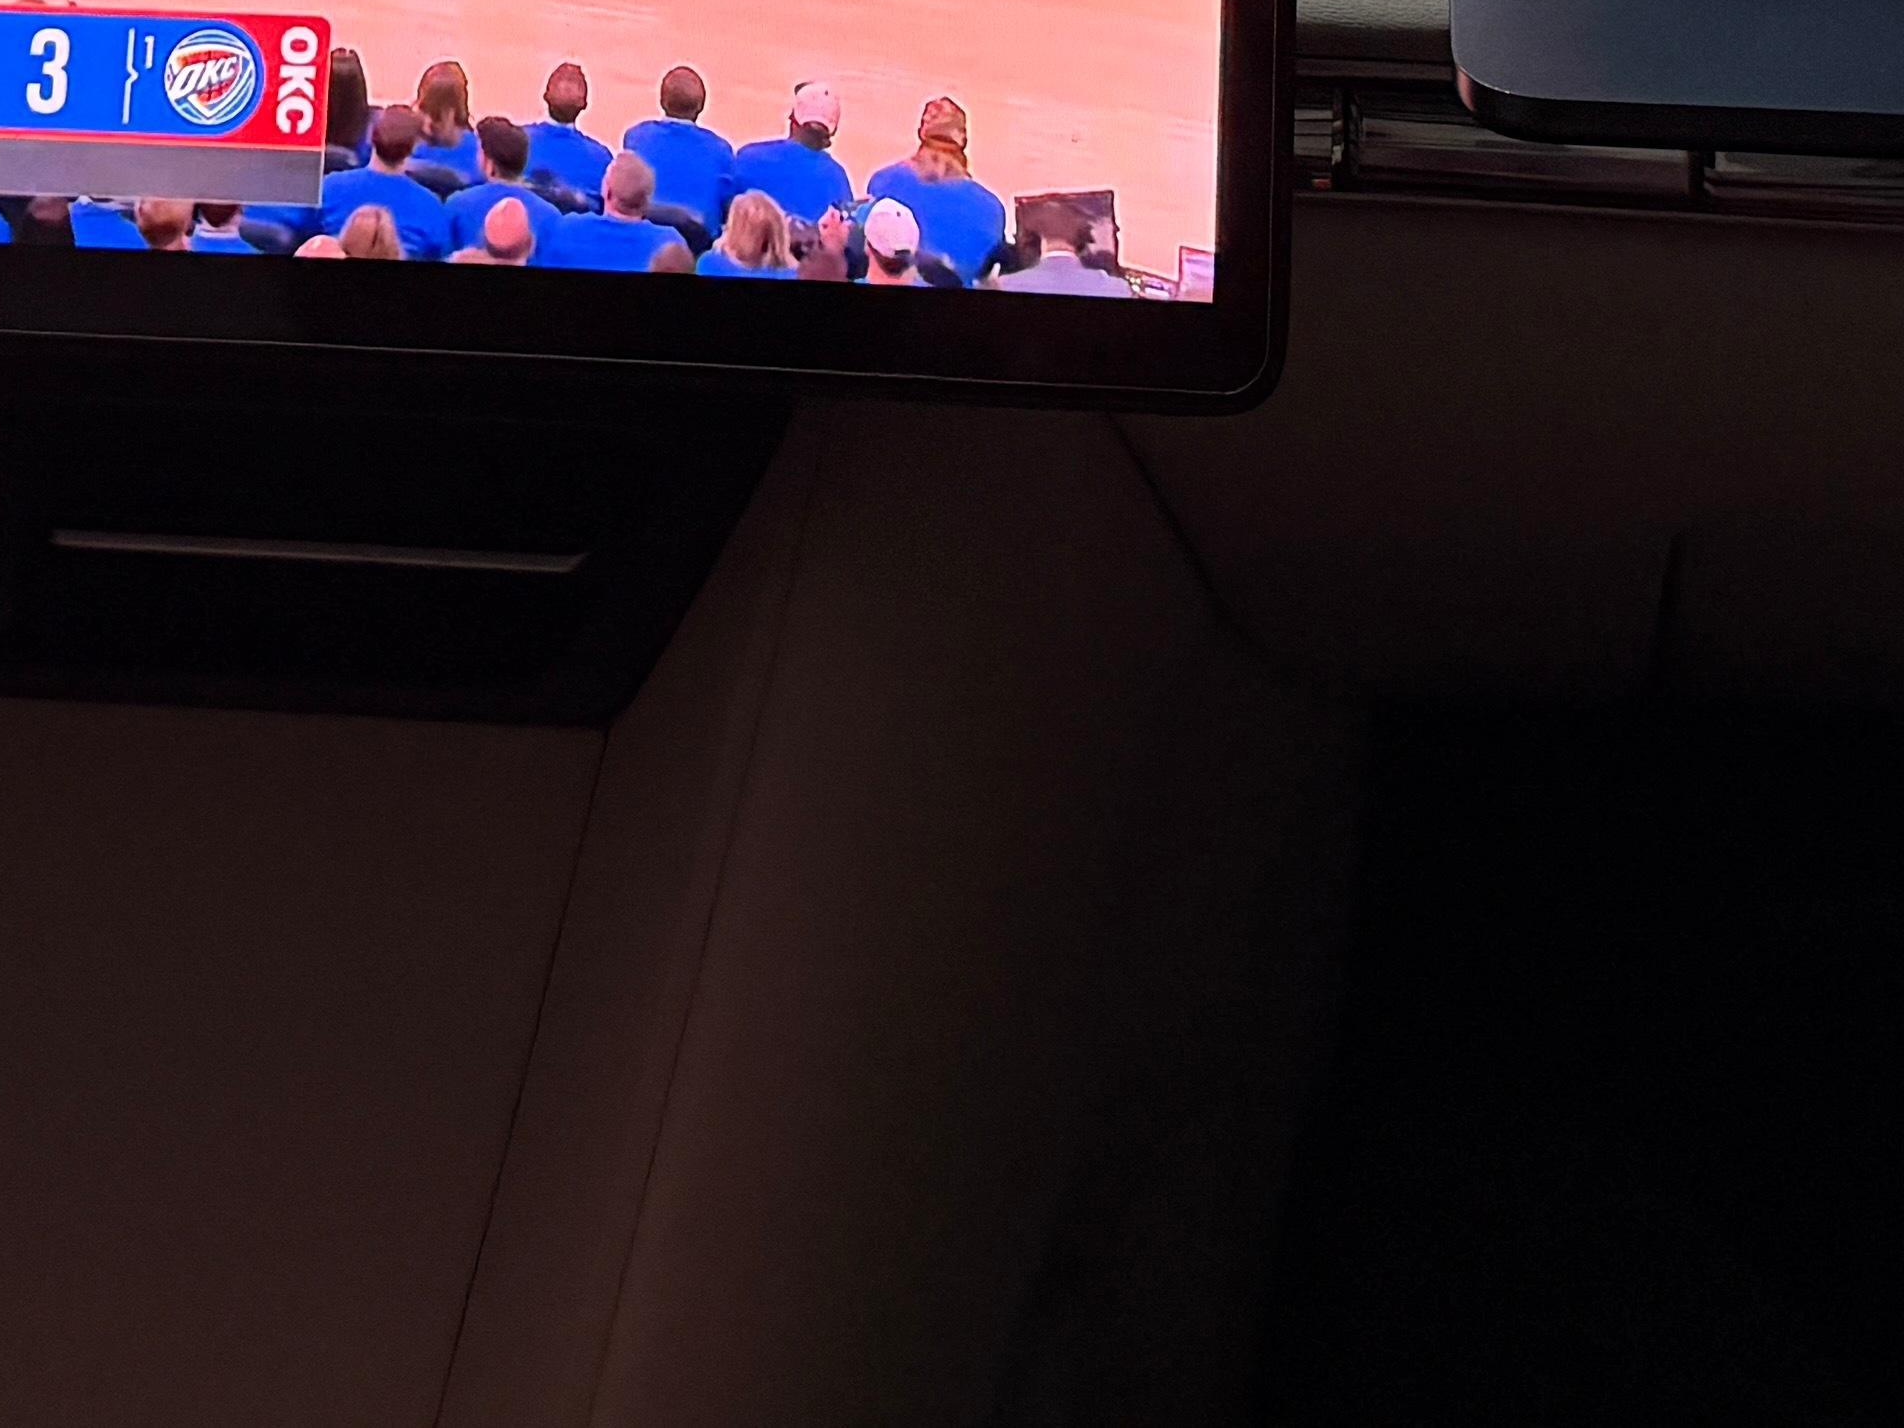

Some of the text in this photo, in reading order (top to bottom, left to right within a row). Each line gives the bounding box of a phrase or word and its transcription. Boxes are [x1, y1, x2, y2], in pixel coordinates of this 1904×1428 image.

[25, 27, 71, 115] 3
[169, 55, 238, 98] OKC
[275, 25, 320, 135] OKC
